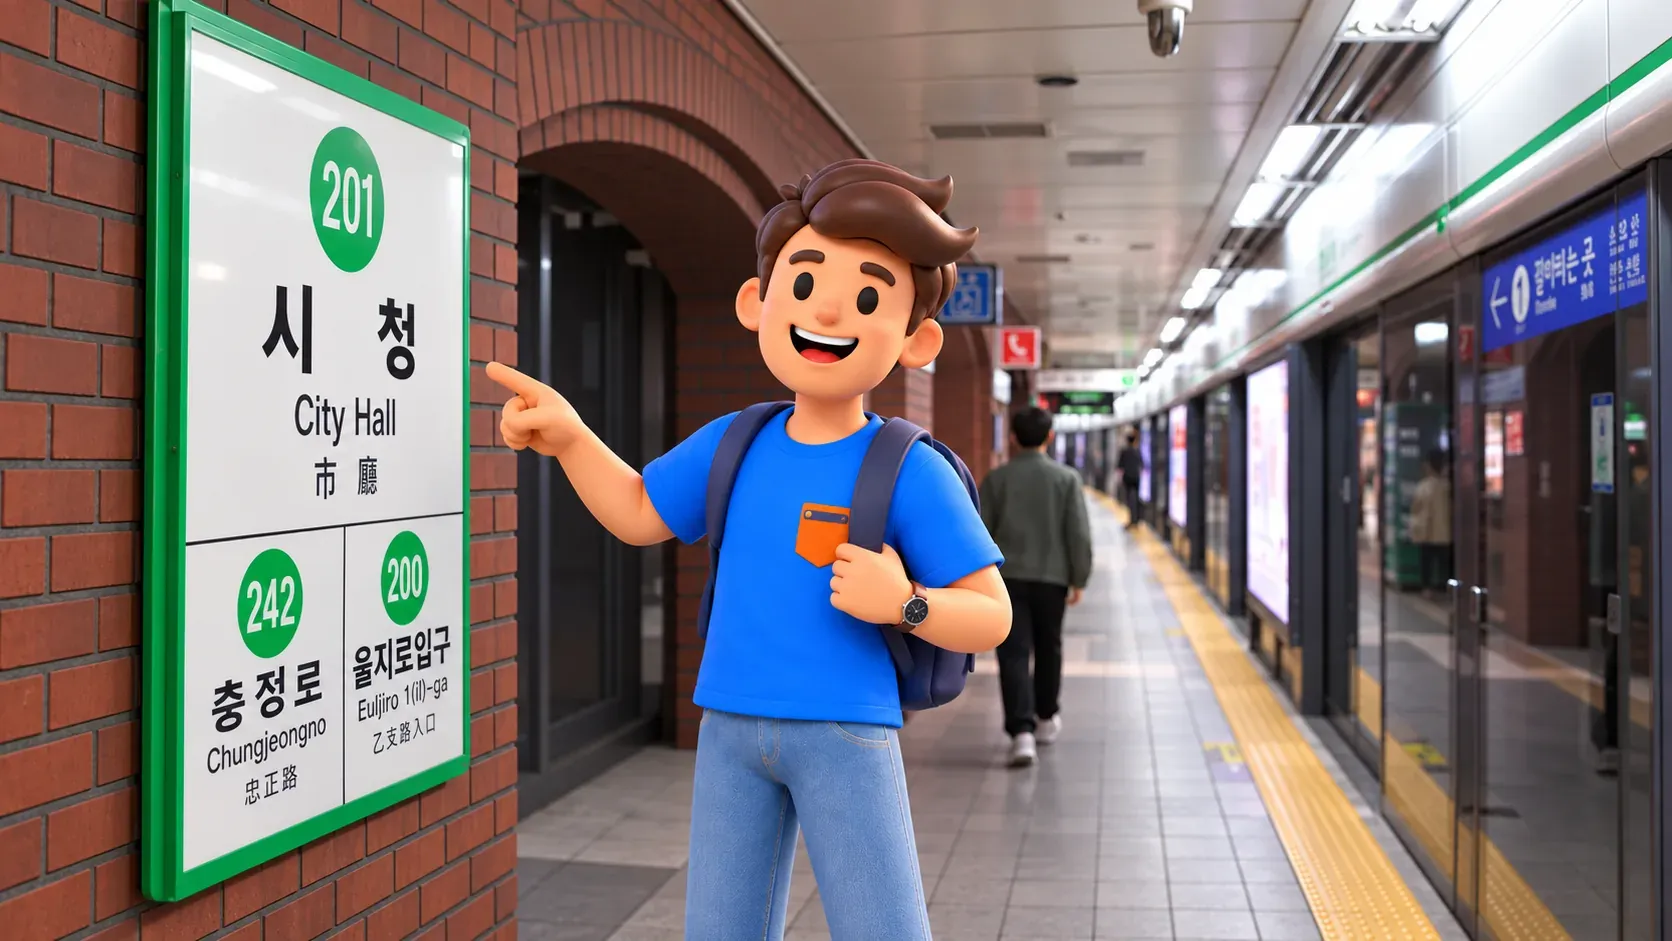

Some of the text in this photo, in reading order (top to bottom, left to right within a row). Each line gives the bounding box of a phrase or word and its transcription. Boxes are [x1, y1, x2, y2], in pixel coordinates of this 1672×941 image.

[321, 160, 375, 239] 201
[262, 285, 415, 380] 시청
[295, 394, 395, 446] City Hall
[315, 456, 377, 499] 市廳
[246, 574, 296, 634] 242
[387, 554, 423, 604] 200
[352, 626, 451, 690] 울지로입구
[211, 660, 323, 733] 충정로
[358, 676, 449, 722] Euljiro 1(il)-ga
[206, 717, 327, 774] Chungjeongno
[372, 712, 437, 755] 乙支路入口
[244, 764, 299, 806] 忠正路
